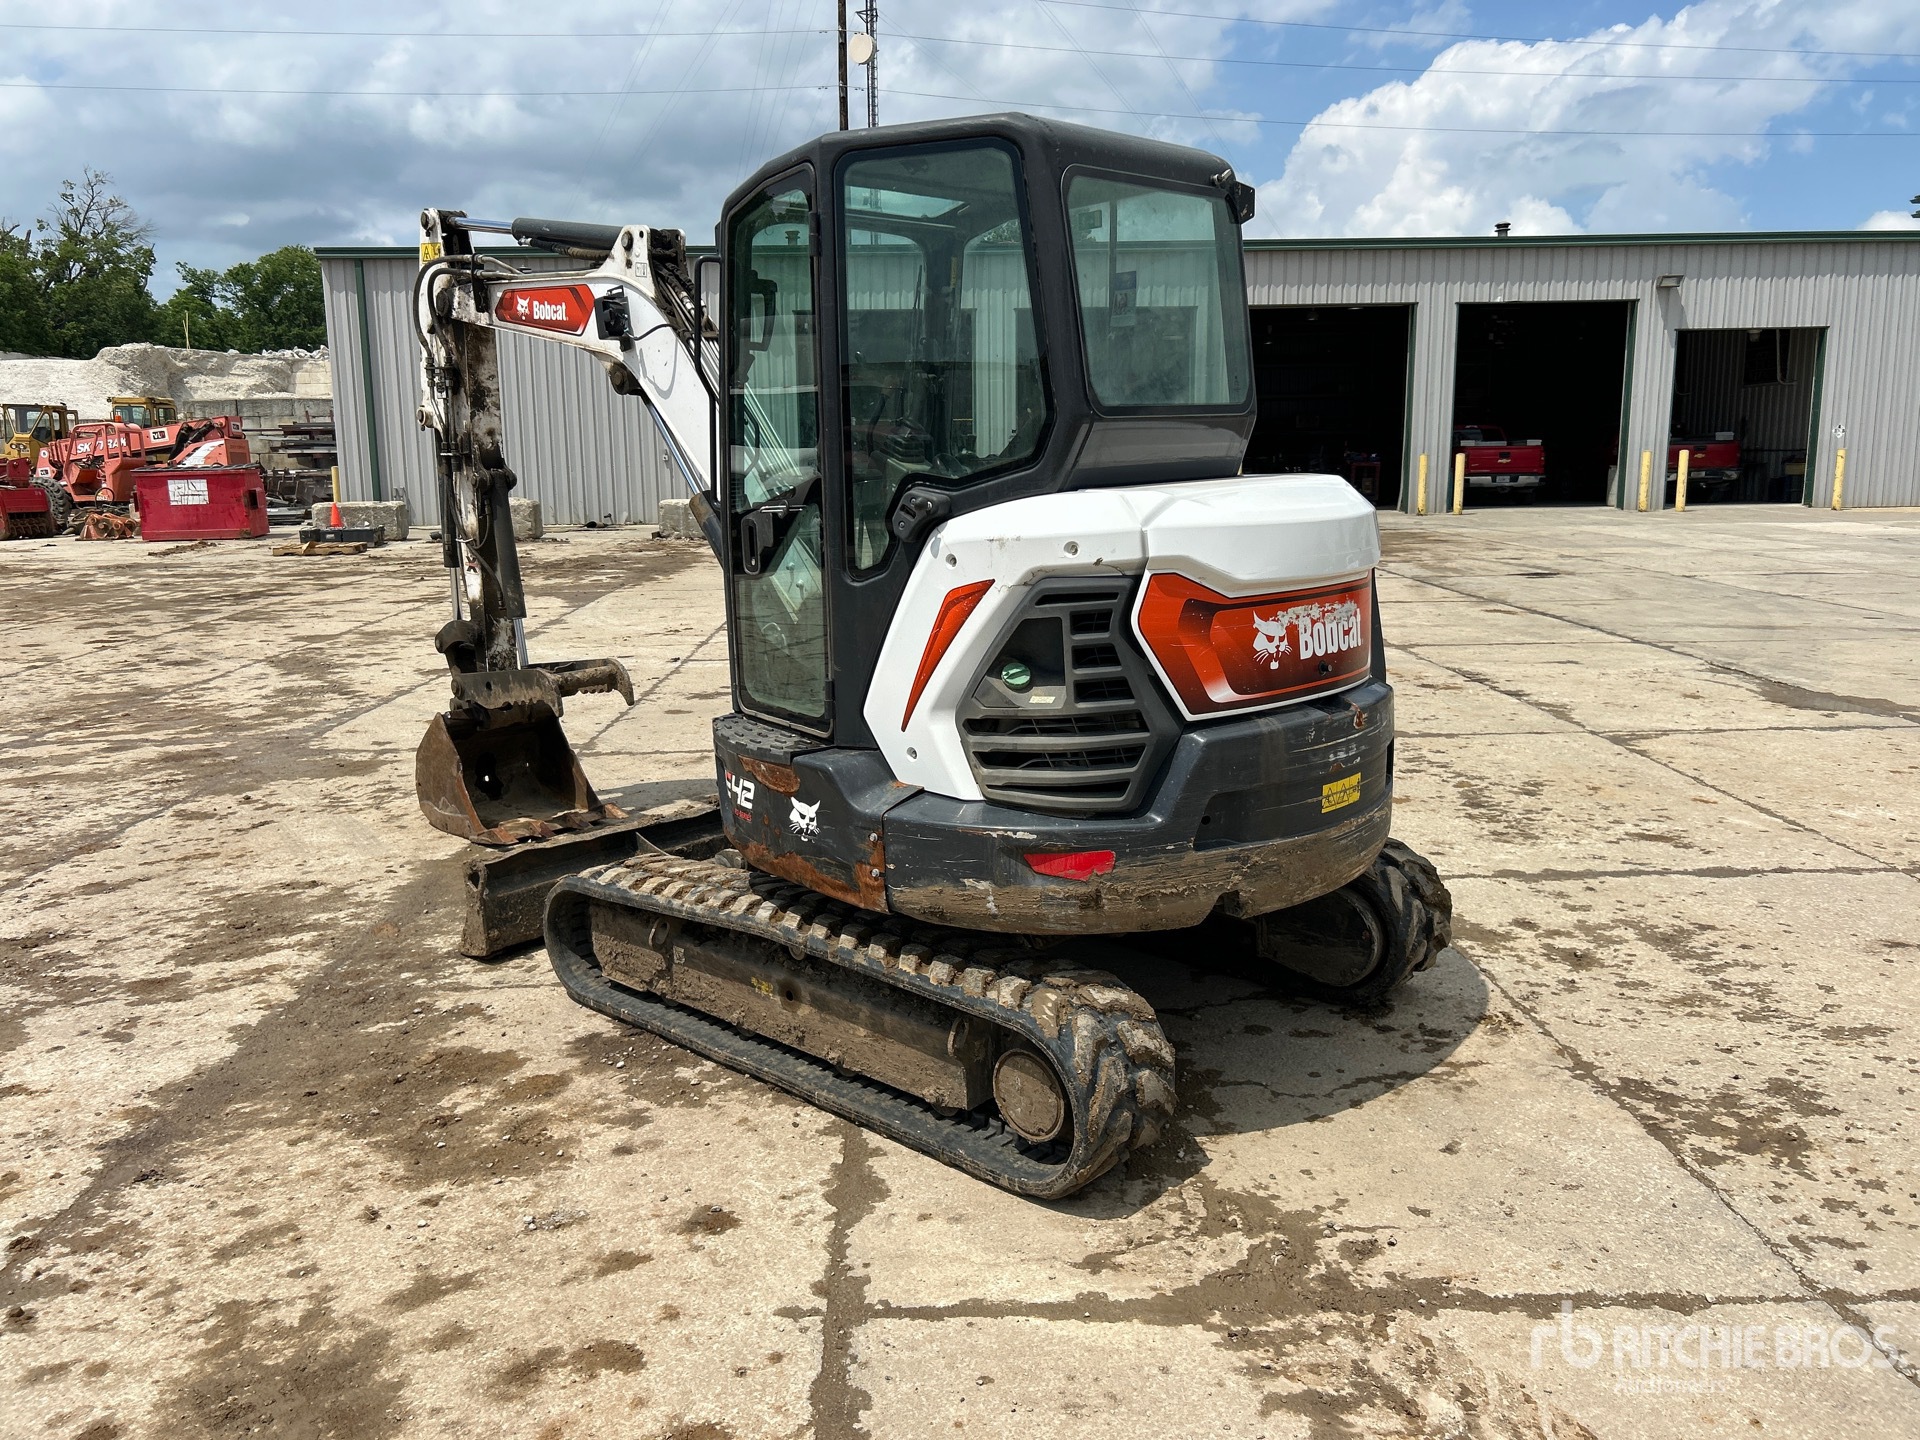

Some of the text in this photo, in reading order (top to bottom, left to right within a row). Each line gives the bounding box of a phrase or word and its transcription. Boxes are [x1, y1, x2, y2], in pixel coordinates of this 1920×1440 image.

[532, 300, 567, 321] Bobcat
[1299, 607, 1361, 659] Bobcat
[725, 770, 755, 809] E42
